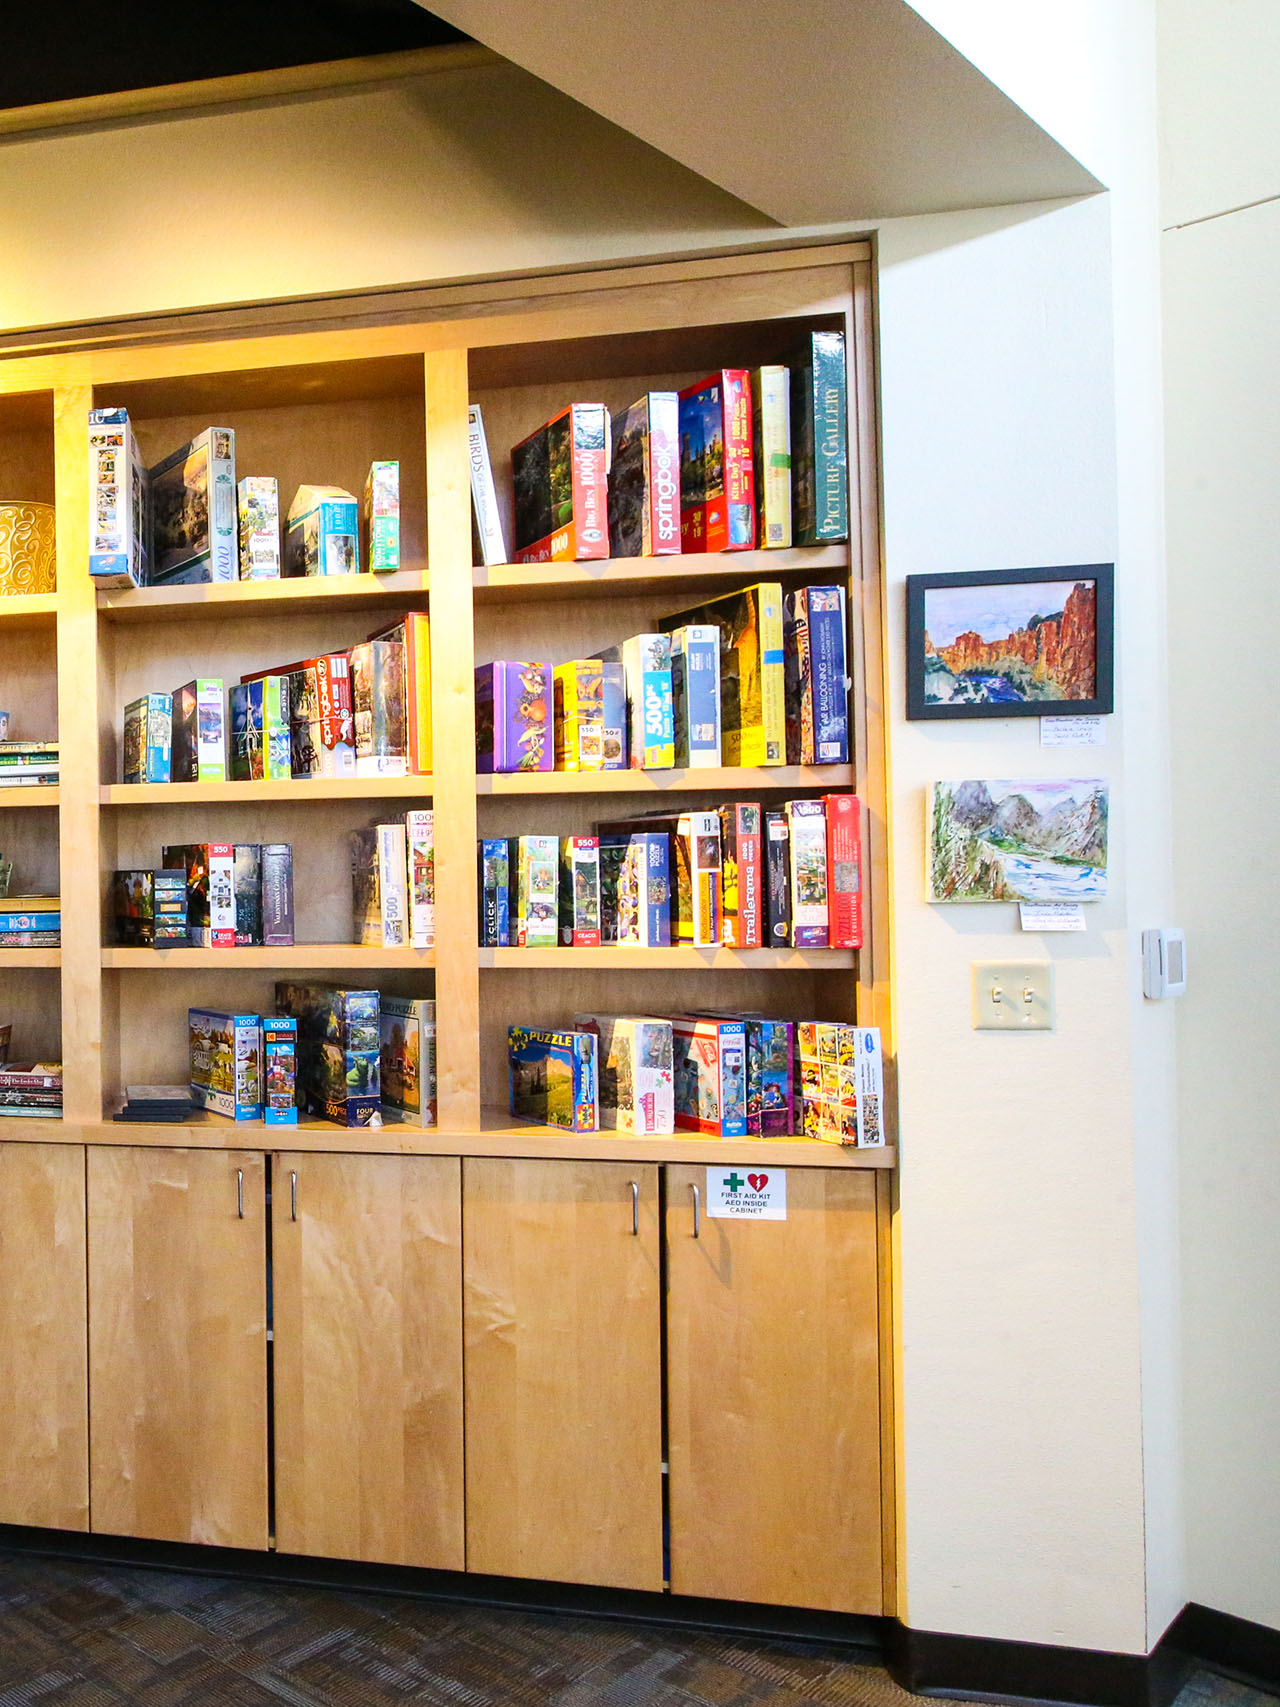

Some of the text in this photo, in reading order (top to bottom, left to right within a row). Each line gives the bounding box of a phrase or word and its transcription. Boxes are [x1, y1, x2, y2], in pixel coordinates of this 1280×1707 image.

[469, 433, 484, 473] BIRDS
[581, 452, 596, 486] 1000
[821, 387, 841, 532] PICTURE GALLERY
[655, 446, 677, 541] springbok
[729, 462, 742, 499] Kite Day
[585, 510, 597, 528] BIG
[551, 532, 569, 557] 1000
[217, 545, 231, 581] 1000
[818, 661, 829, 712] BALLOONING
[318, 675, 333, 745] springbok
[577, 839, 593, 847] 550
[386, 897, 398, 918] 500
[487, 901, 495, 934] CLICK
[743, 866, 756, 945] Trailerama
[529, 1032, 572, 1047] PUZZLE
[723, 1025, 742, 1033] 1000
[219, 1097, 234, 1110] 1000
[326, 1103, 338, 1116] 500
[656, 1109, 666, 1128] 750
